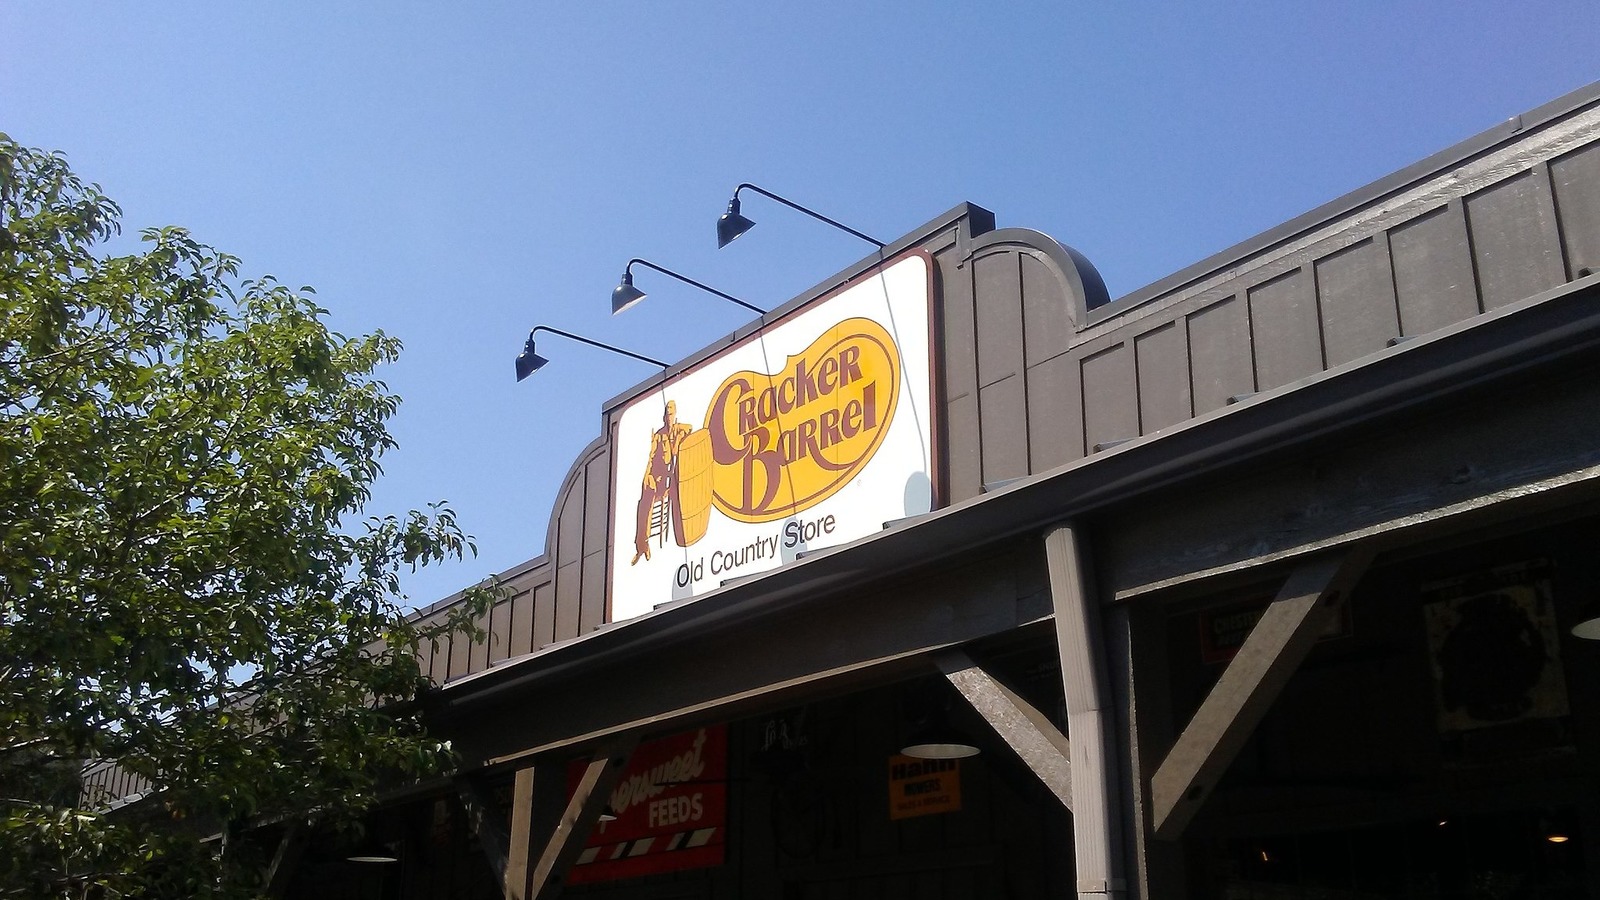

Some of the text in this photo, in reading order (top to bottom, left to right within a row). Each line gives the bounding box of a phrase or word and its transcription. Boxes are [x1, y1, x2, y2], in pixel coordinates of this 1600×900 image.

[708, 345, 863, 466] Cracker
[742, 380, 877, 515] Barrel
[676, 514, 836, 588] Old Country Store
[648, 792, 704, 829] FEEDS
